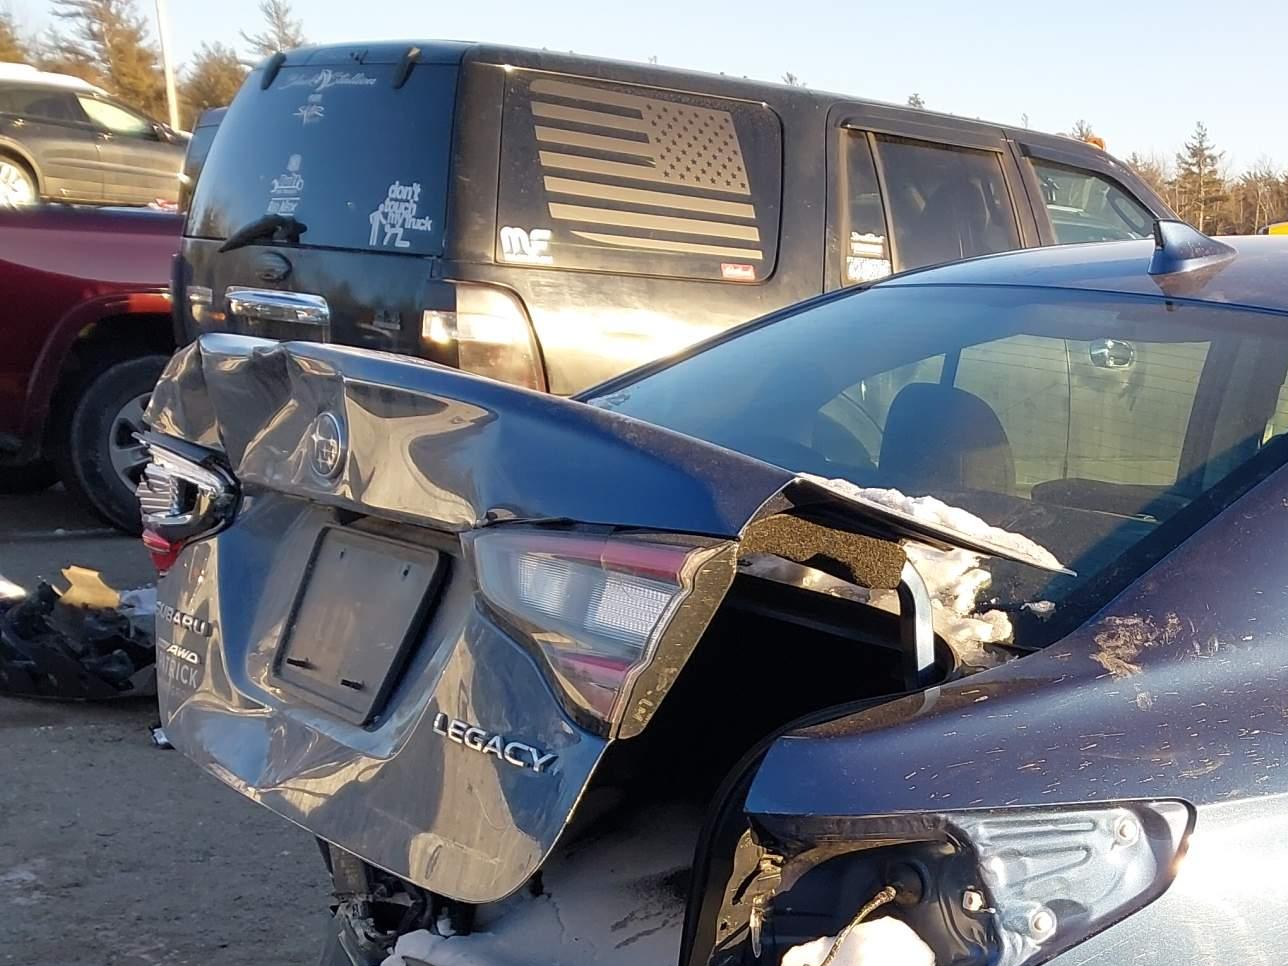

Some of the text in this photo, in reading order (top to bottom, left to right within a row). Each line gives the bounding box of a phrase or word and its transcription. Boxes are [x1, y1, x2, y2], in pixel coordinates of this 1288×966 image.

[388, 181, 421, 201] don't
[155, 601, 206, 635] SUBARU
[166, 644, 198, 664] AWD
[433, 712, 557, 772] LEGACY
